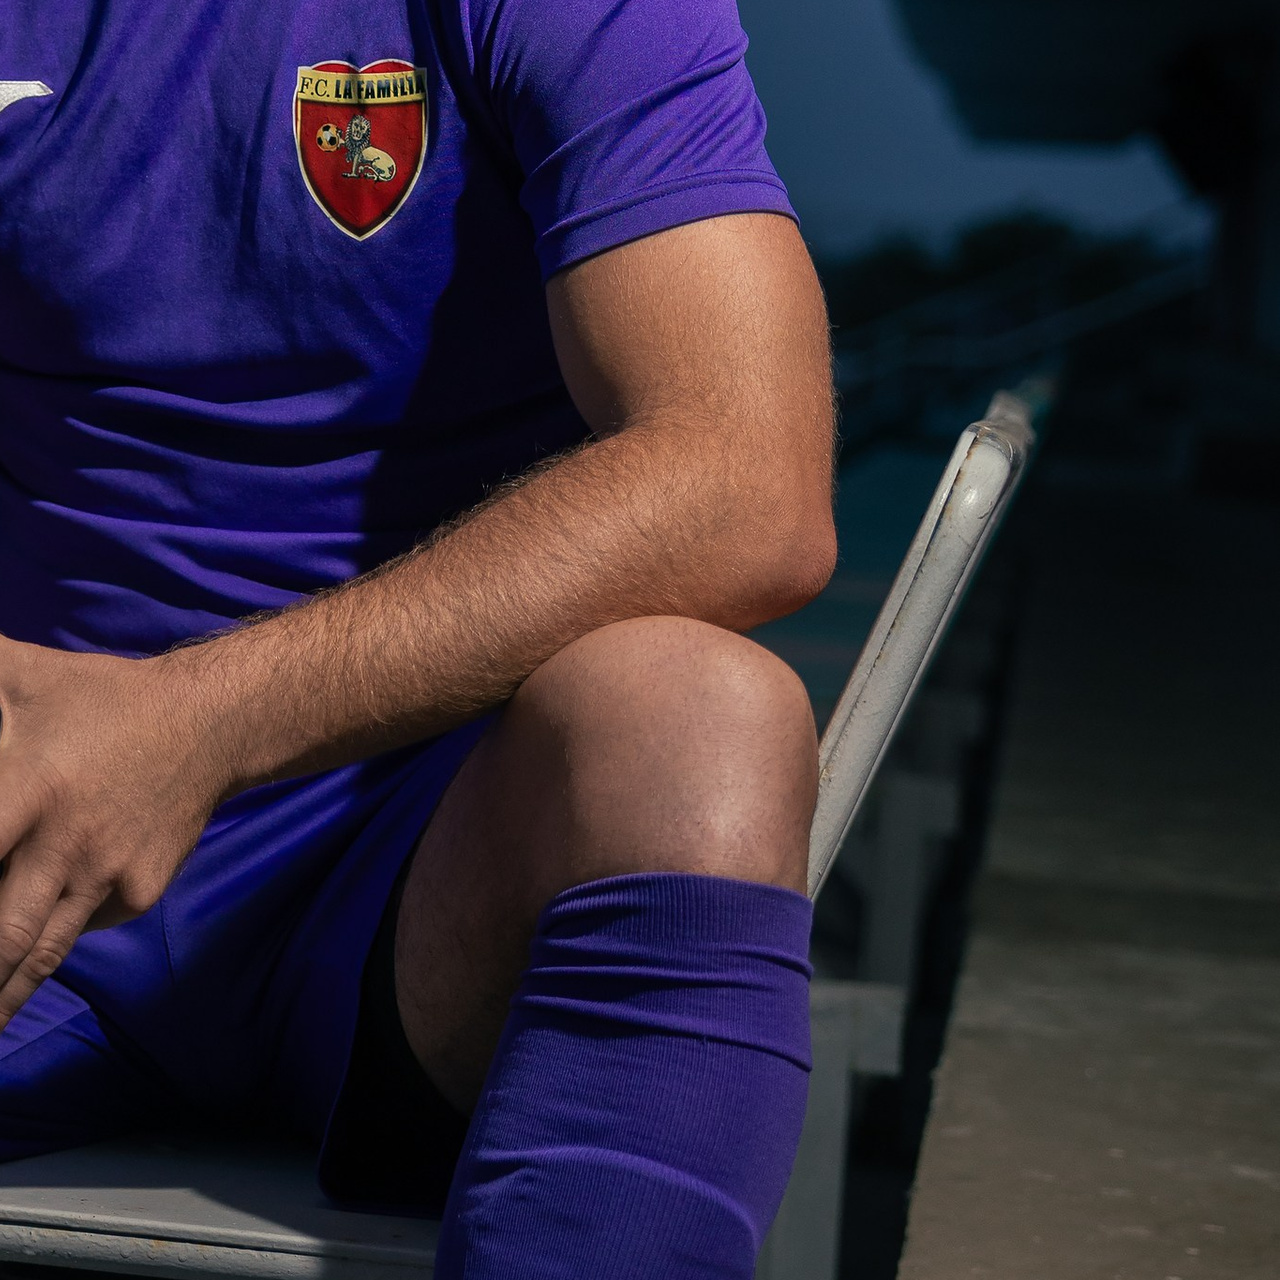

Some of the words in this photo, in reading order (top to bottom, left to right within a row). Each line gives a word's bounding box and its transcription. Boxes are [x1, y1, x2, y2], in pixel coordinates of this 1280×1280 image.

[300, 76, 330, 98] F.C.
[334, 79, 352, 99] LA
[357, 74, 426, 100] FAMILIA
